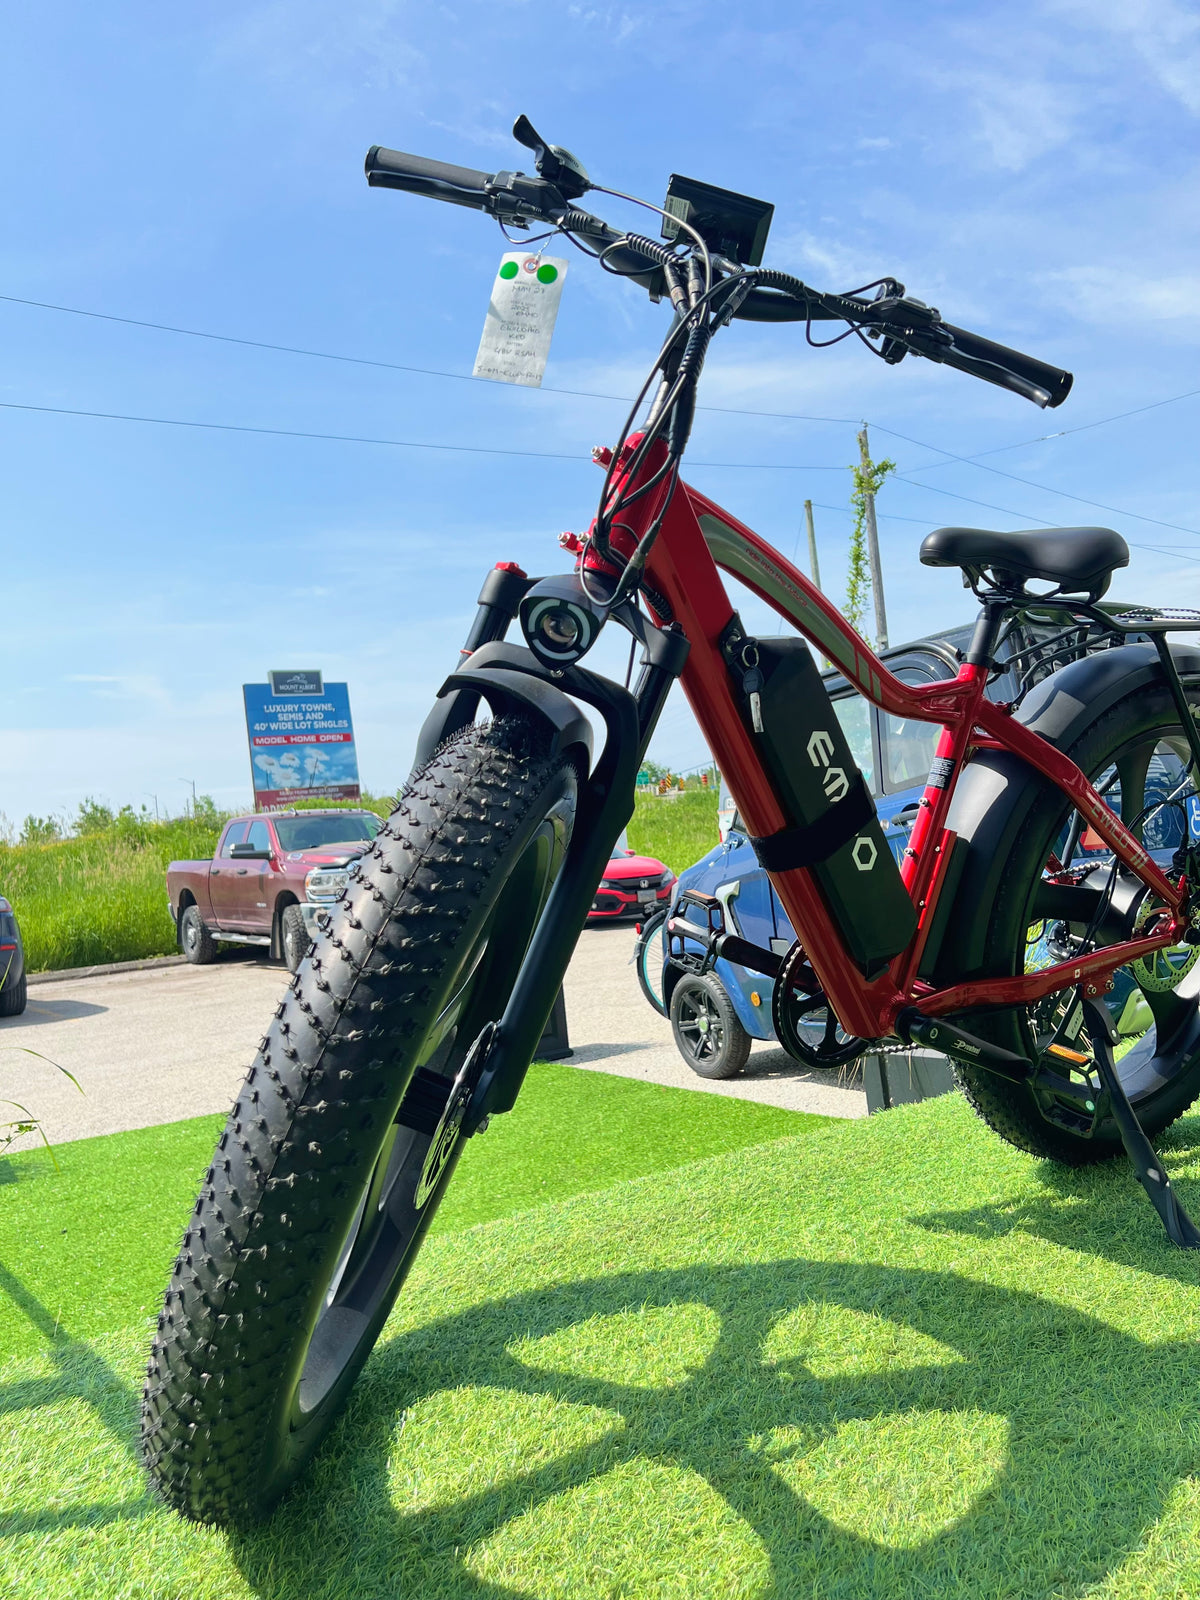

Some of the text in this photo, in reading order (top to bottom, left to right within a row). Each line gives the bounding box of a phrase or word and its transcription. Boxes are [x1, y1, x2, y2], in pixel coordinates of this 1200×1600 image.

[264, 703, 336, 713] LUXURY TOWNS,
[277, 712, 324, 721] SEMIS AND
[254, 719, 349, 731] 40' WIDE LOT SINGLES
[255, 733, 344, 745] MODEL HOME OPEN
[806, 730, 878, 871] EMO
